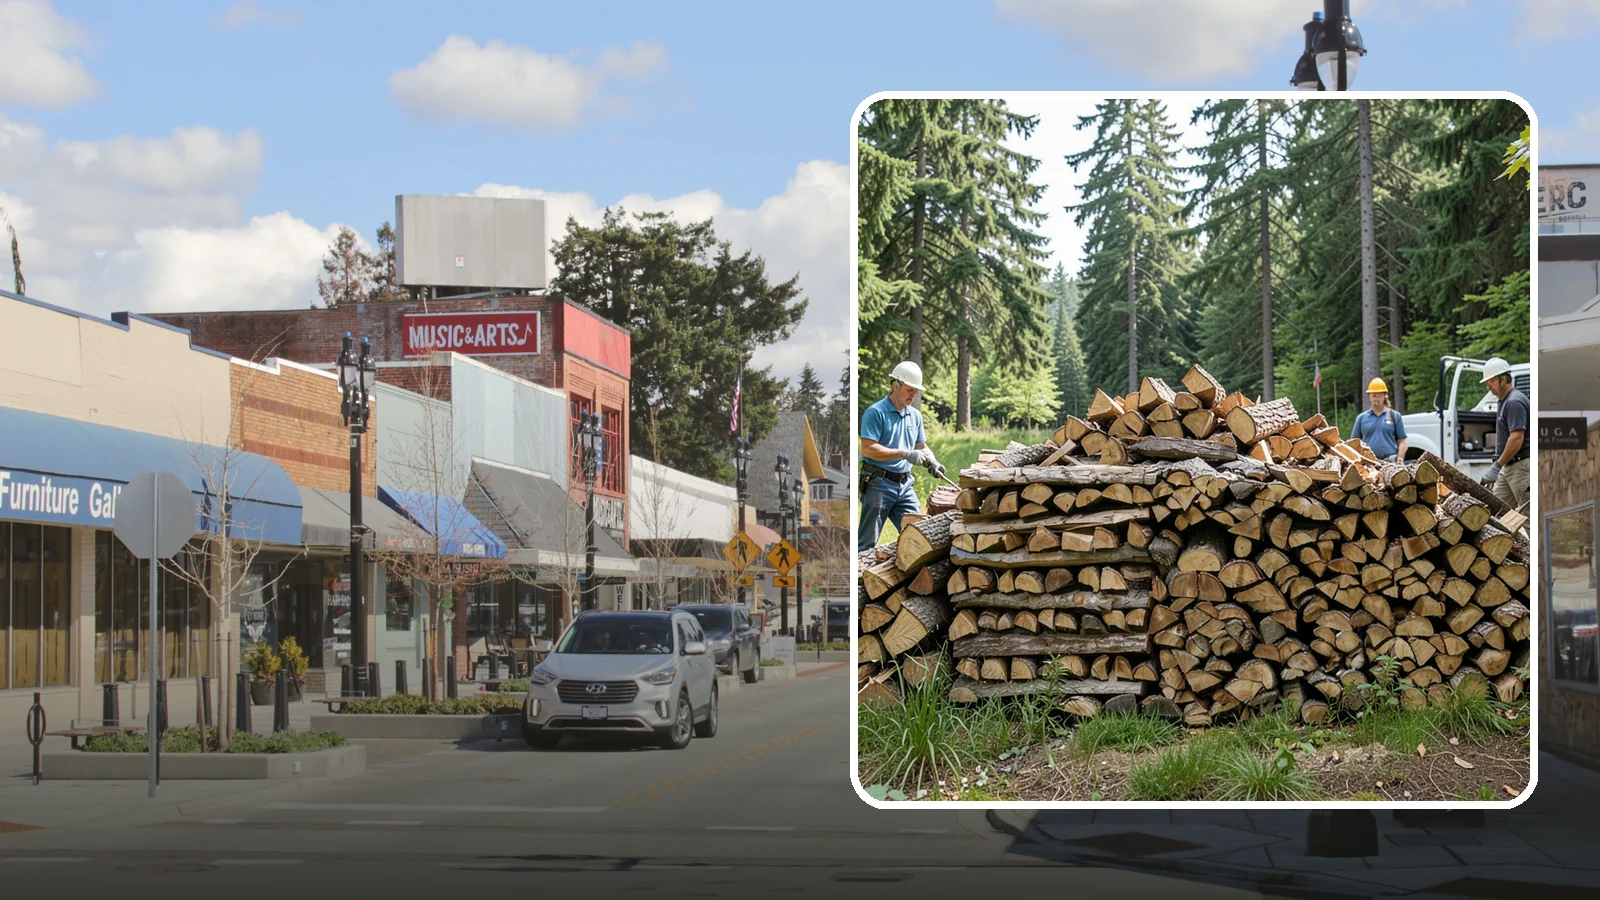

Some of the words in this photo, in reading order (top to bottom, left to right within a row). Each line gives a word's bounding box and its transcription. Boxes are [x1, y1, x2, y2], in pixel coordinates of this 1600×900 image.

[409, 323, 519, 349] MUSIC&ARTS
[0, 472, 79, 515] Furniture
[90, 483, 122, 519] Gal
